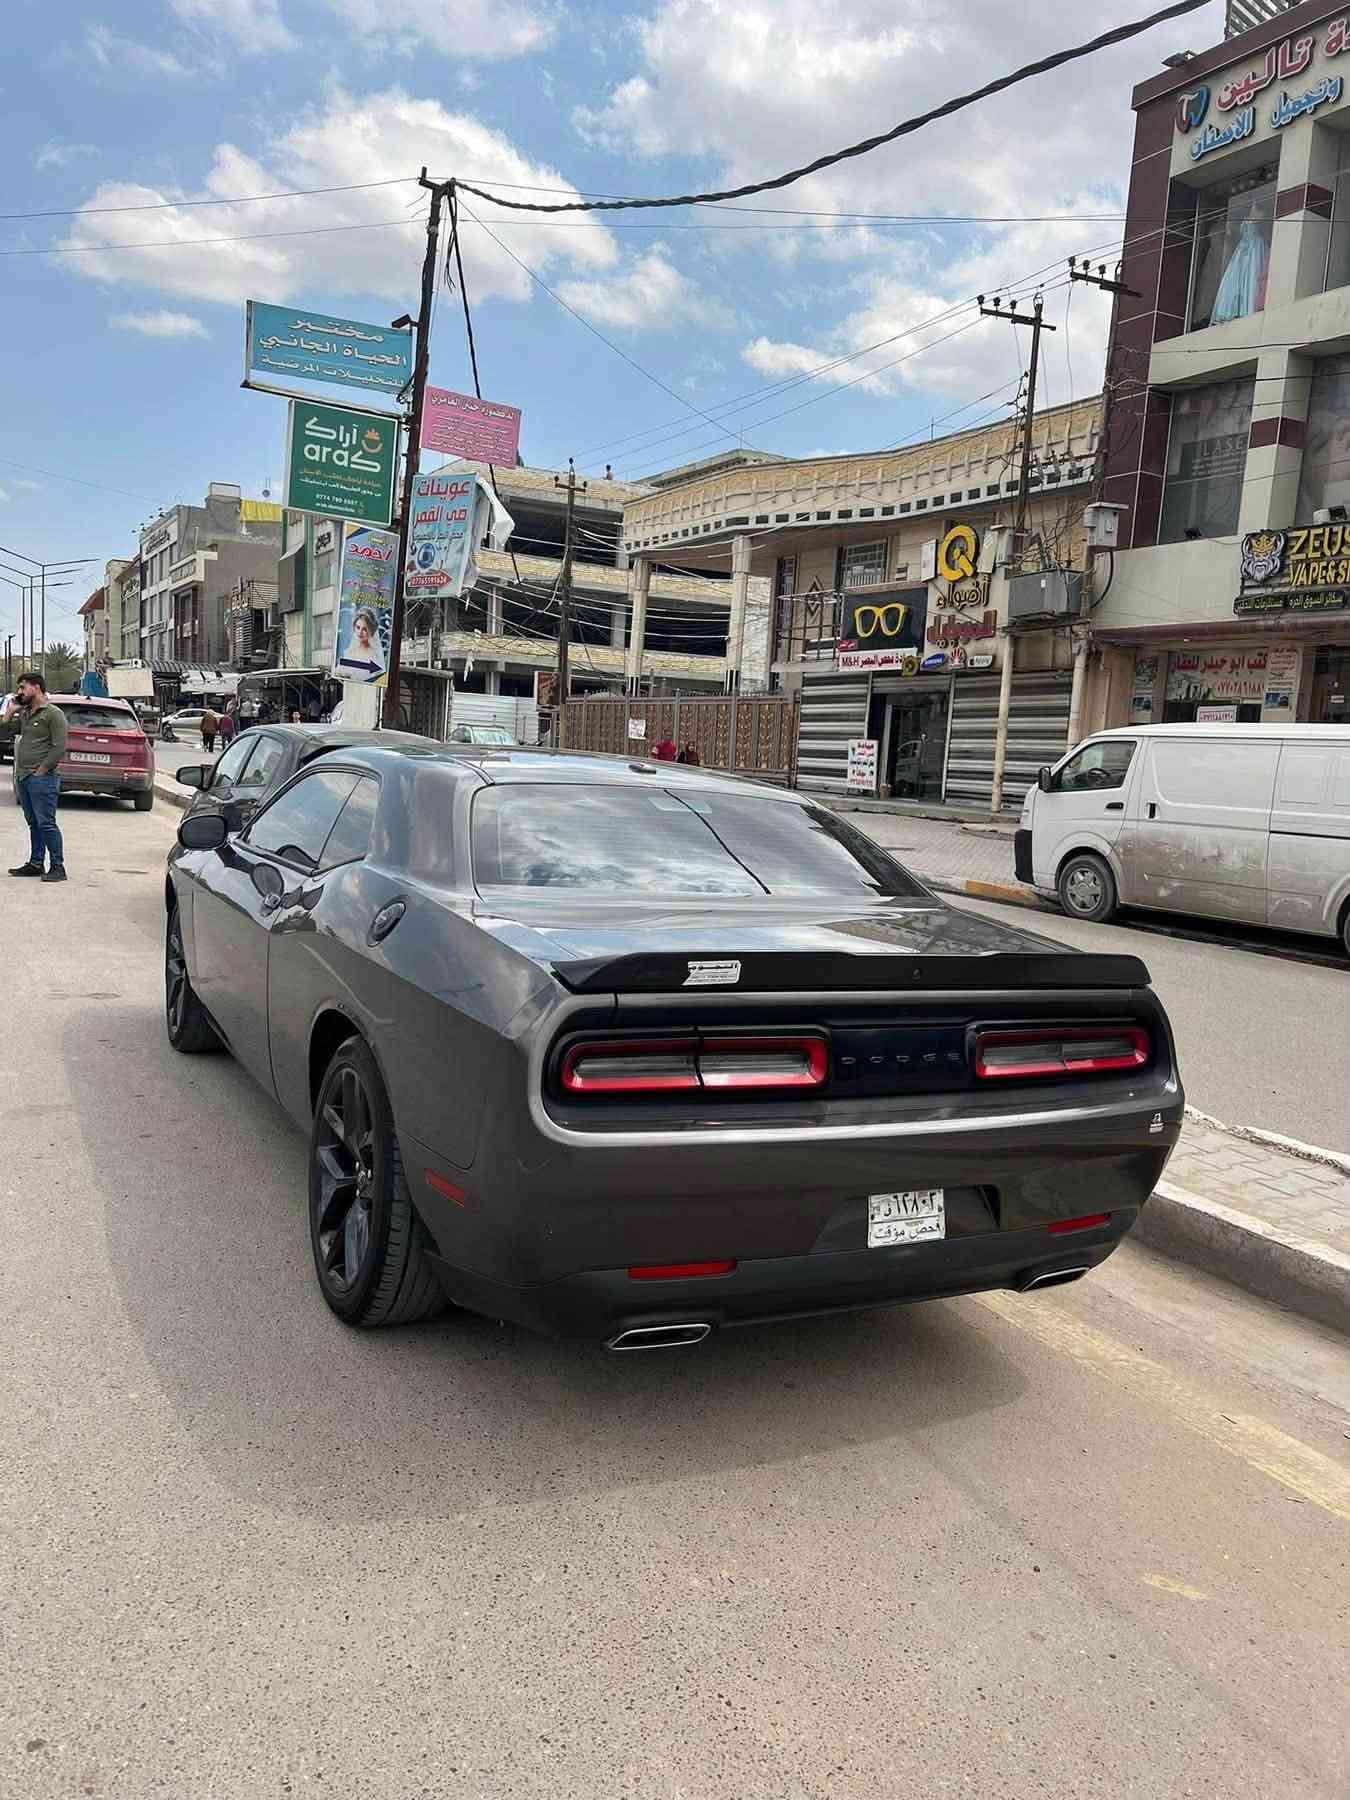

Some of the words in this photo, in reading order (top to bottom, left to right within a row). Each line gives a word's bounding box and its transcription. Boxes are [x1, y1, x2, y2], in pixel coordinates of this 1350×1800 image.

[1270, 76, 1343, 130] وتجميل
[288, 318, 384, 344] مختبر
[343, 344, 407, 368] الحياة
[1203, 433, 1246, 457] LASE
[416, 479, 470, 501] عوينات
[935, 574, 993, 611] أضواء
[841, 1052, 961, 1064] DODGE
